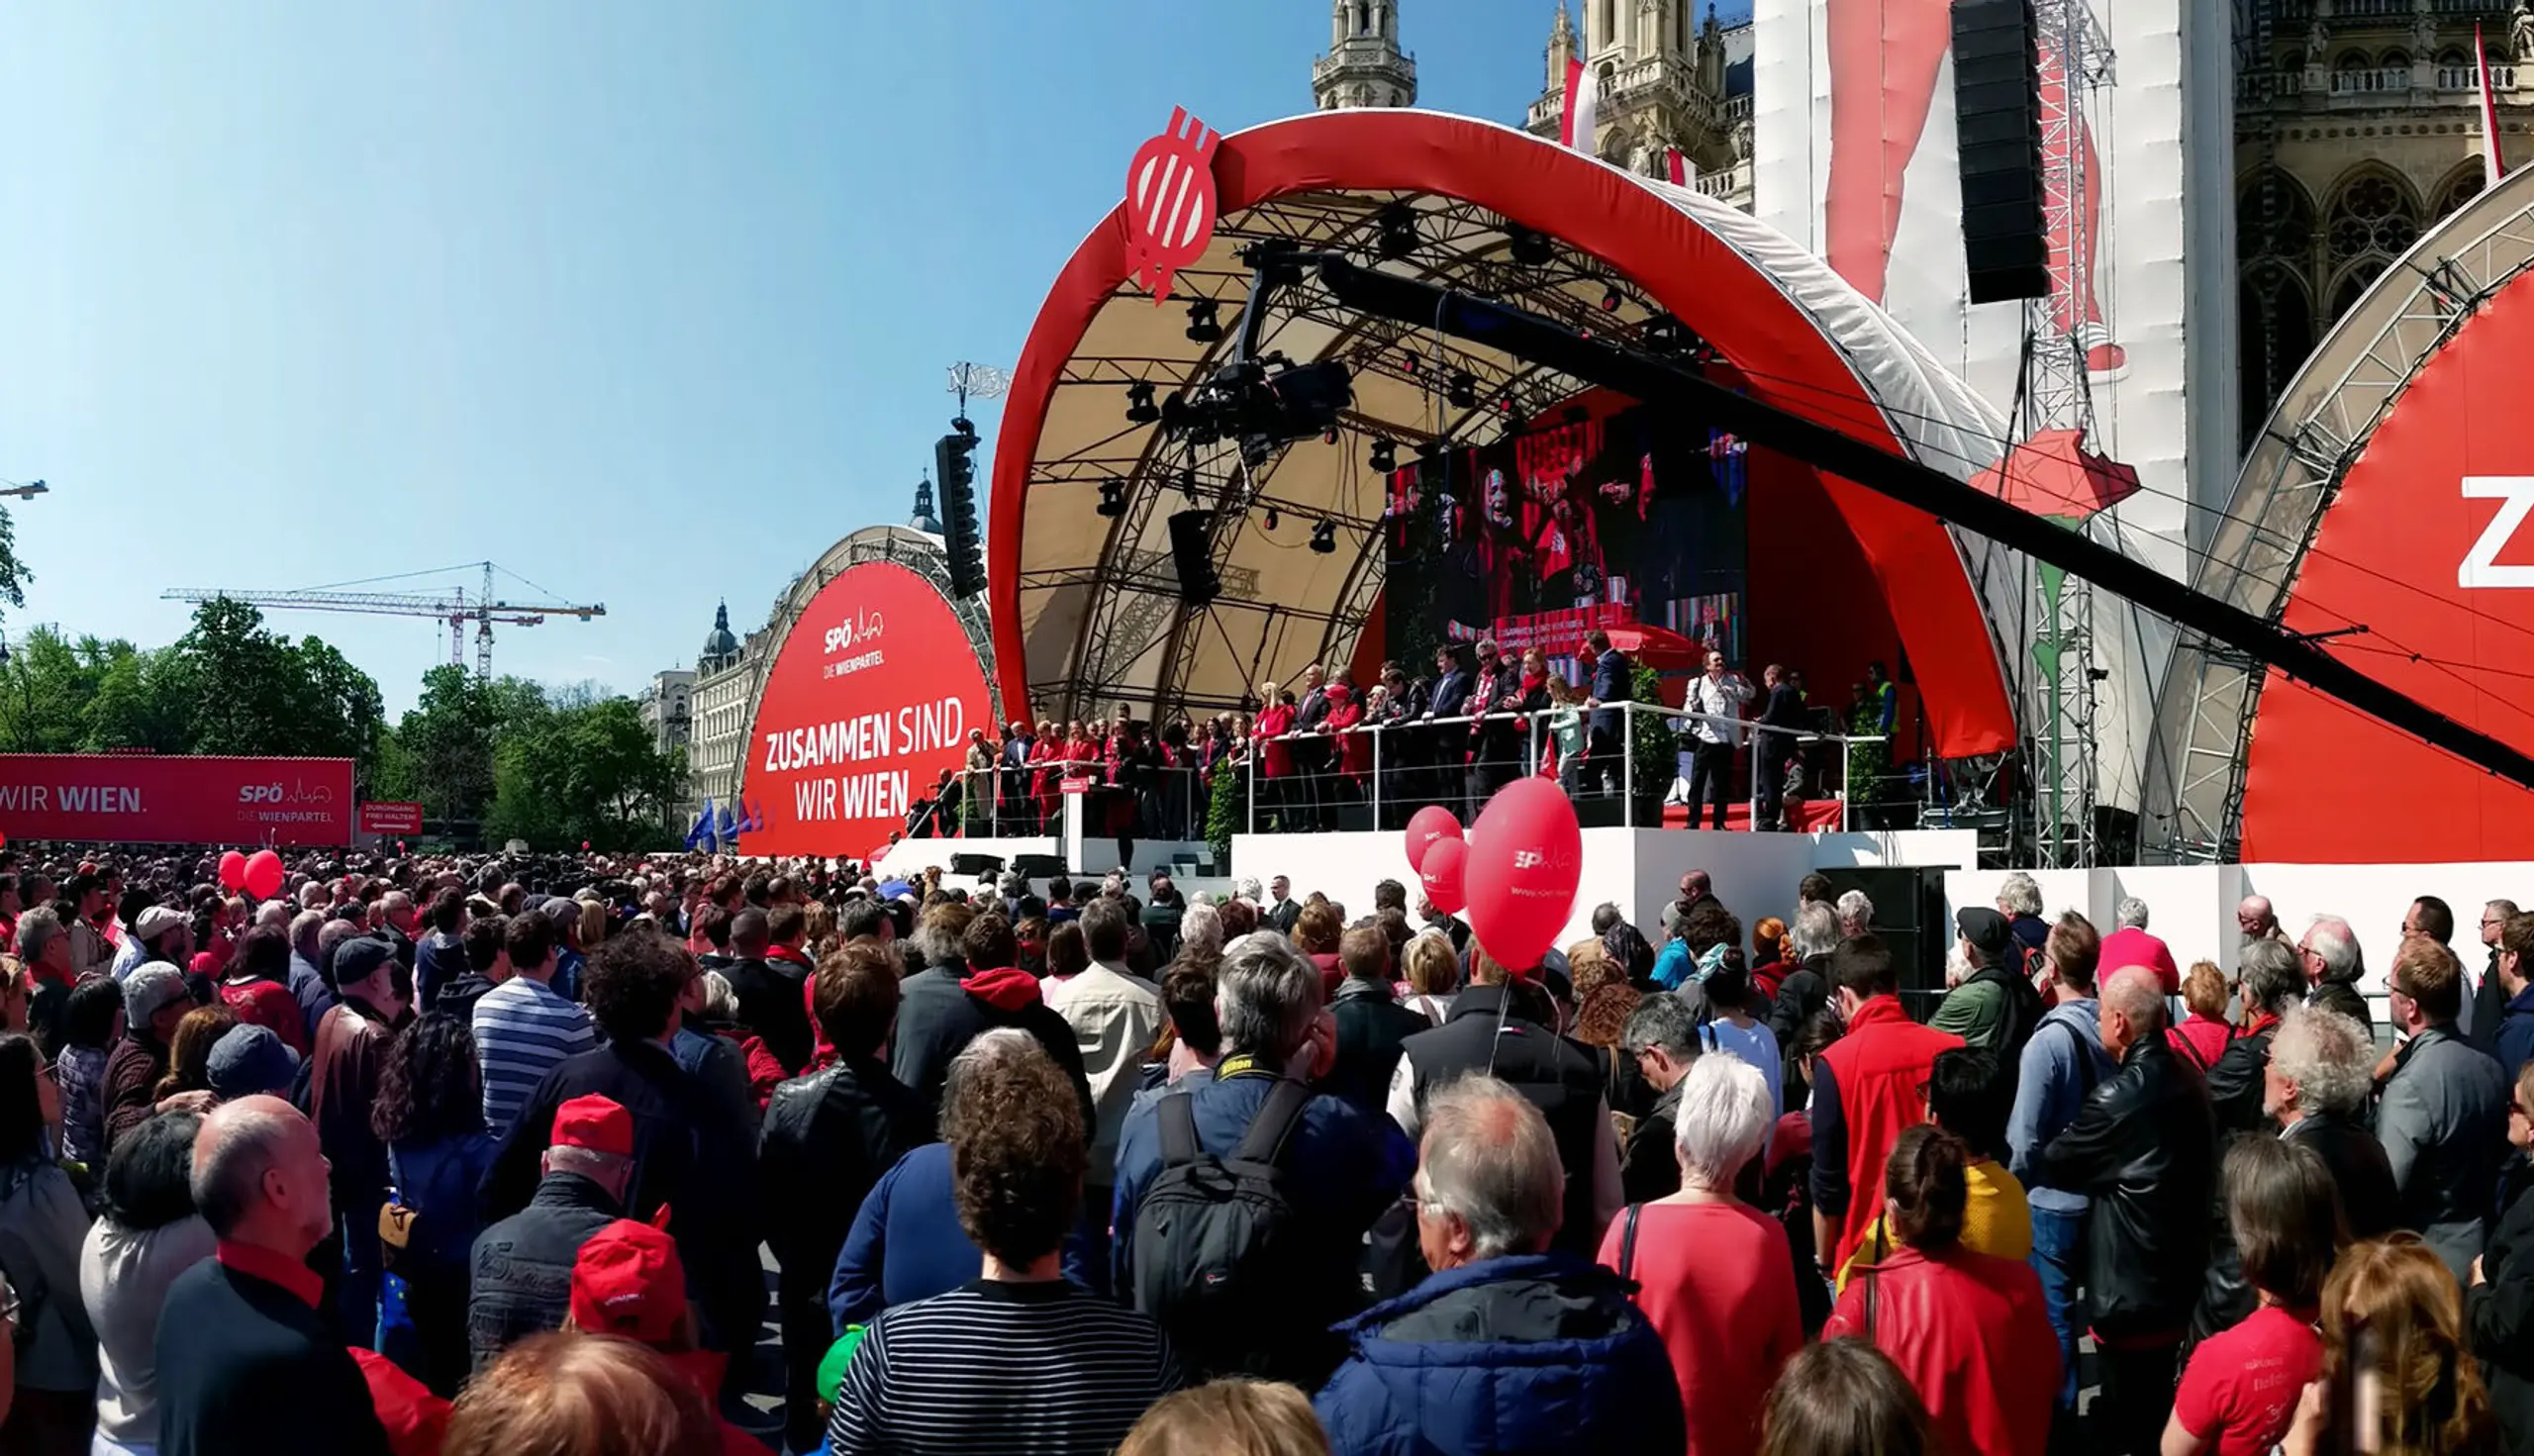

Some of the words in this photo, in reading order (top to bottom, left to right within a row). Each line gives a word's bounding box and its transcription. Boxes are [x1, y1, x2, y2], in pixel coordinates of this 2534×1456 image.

[825, 618, 852, 654] SPÖ
[765, 712, 891, 773] ZUSAMMEN
[898, 697, 963, 755] SIND
[57, 786, 147, 813] WIEN.
[239, 782, 284, 803] SPÖ
[795, 778, 836, 822] WIR
[842, 770, 910, 820] WIEN
